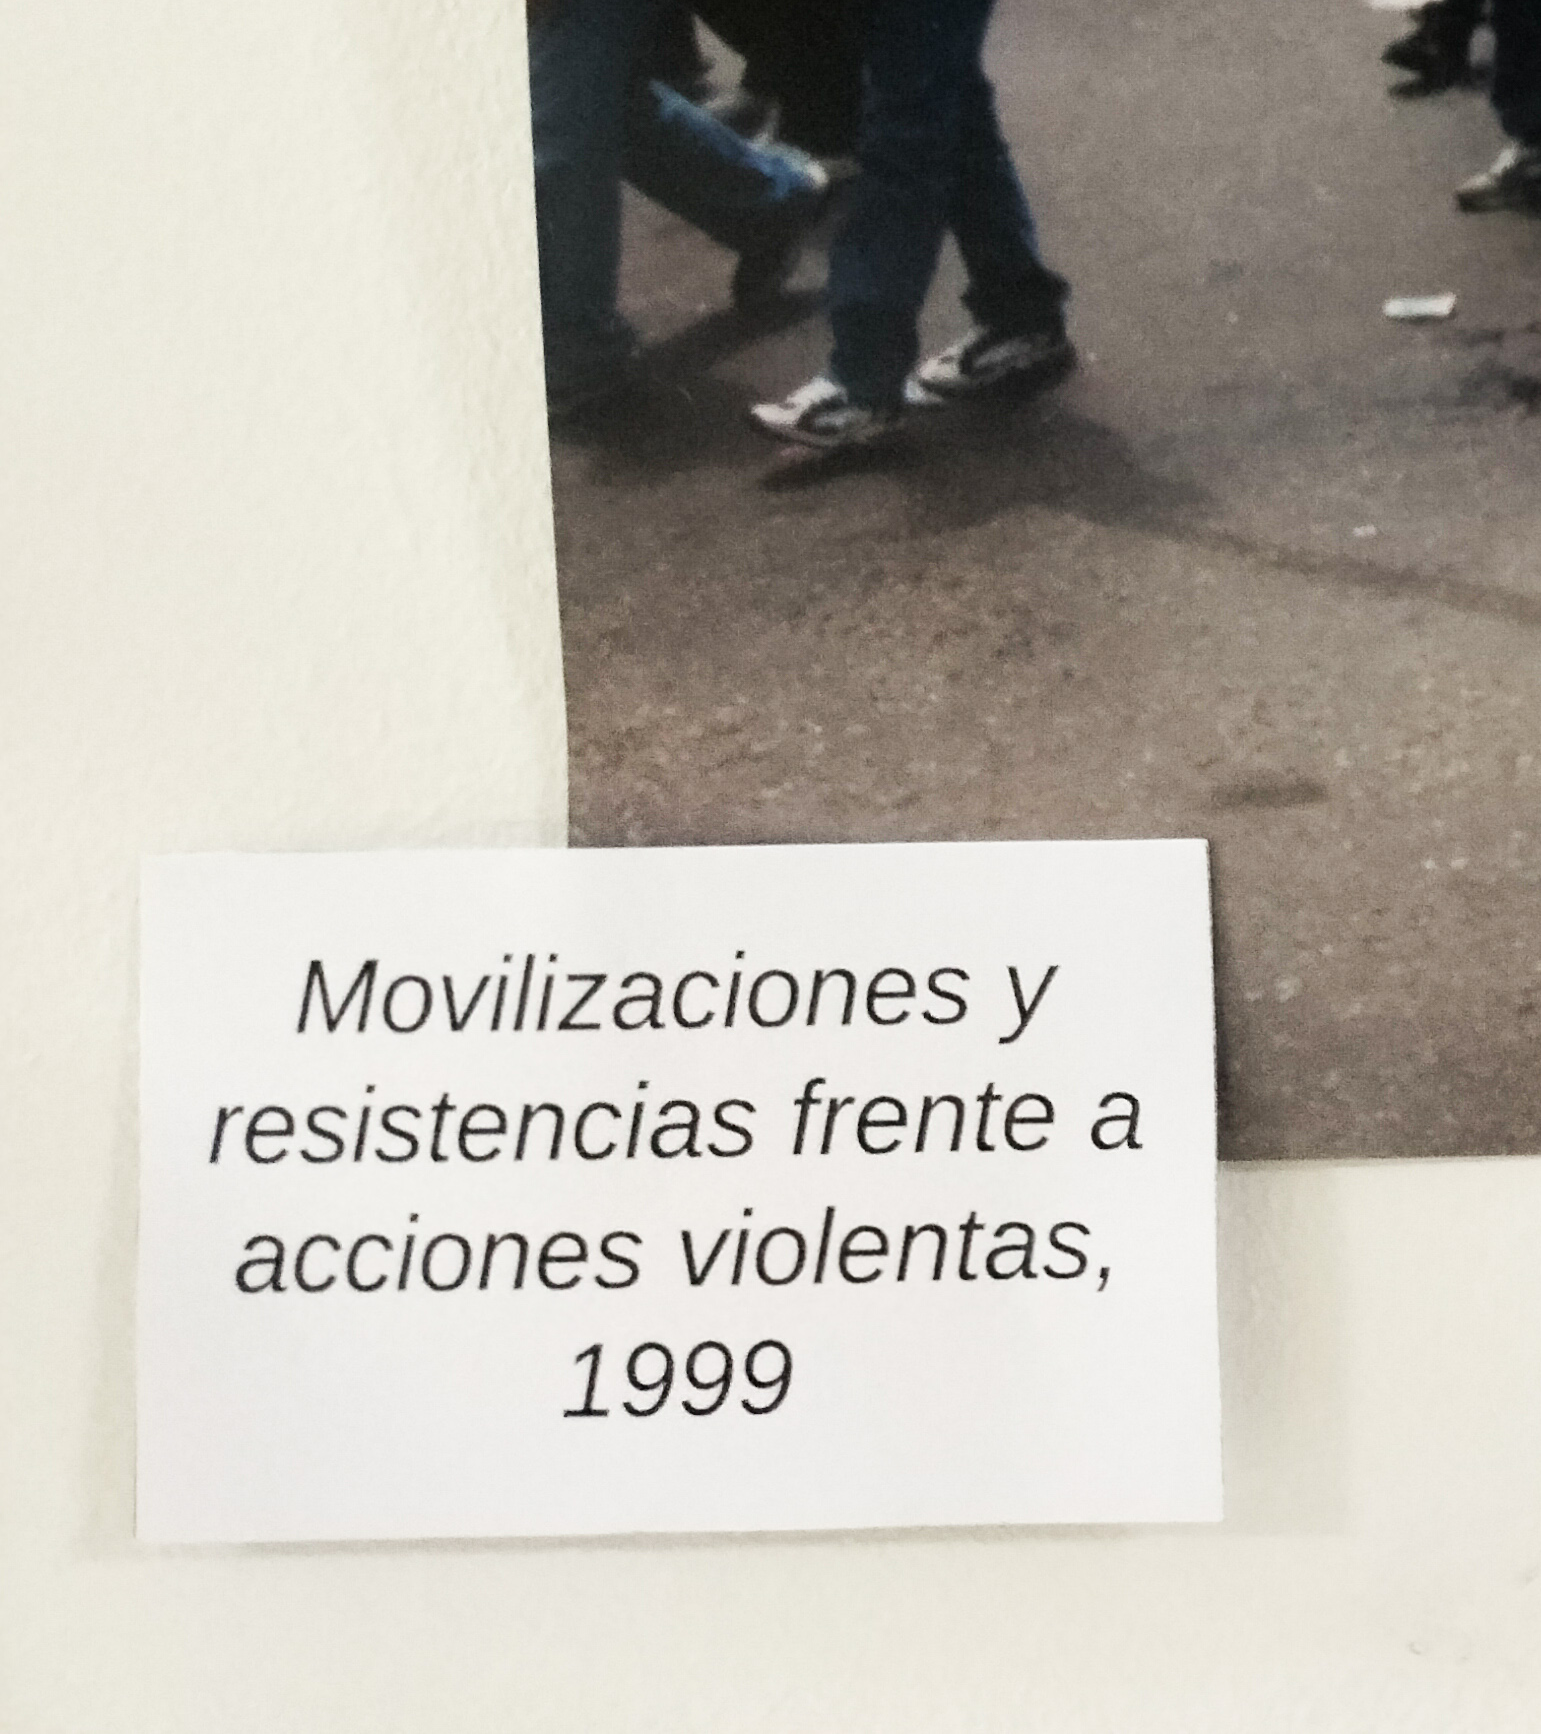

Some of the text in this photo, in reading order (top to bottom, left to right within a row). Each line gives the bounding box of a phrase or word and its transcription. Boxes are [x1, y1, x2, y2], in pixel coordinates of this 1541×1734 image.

[296, 950, 1058, 1045] Movilizaciones y
[208, 1078, 1143, 1165] resistencias frente a
[233, 1209, 1113, 1294] acciones violentas,
[562, 1339, 794, 1420] 1999
